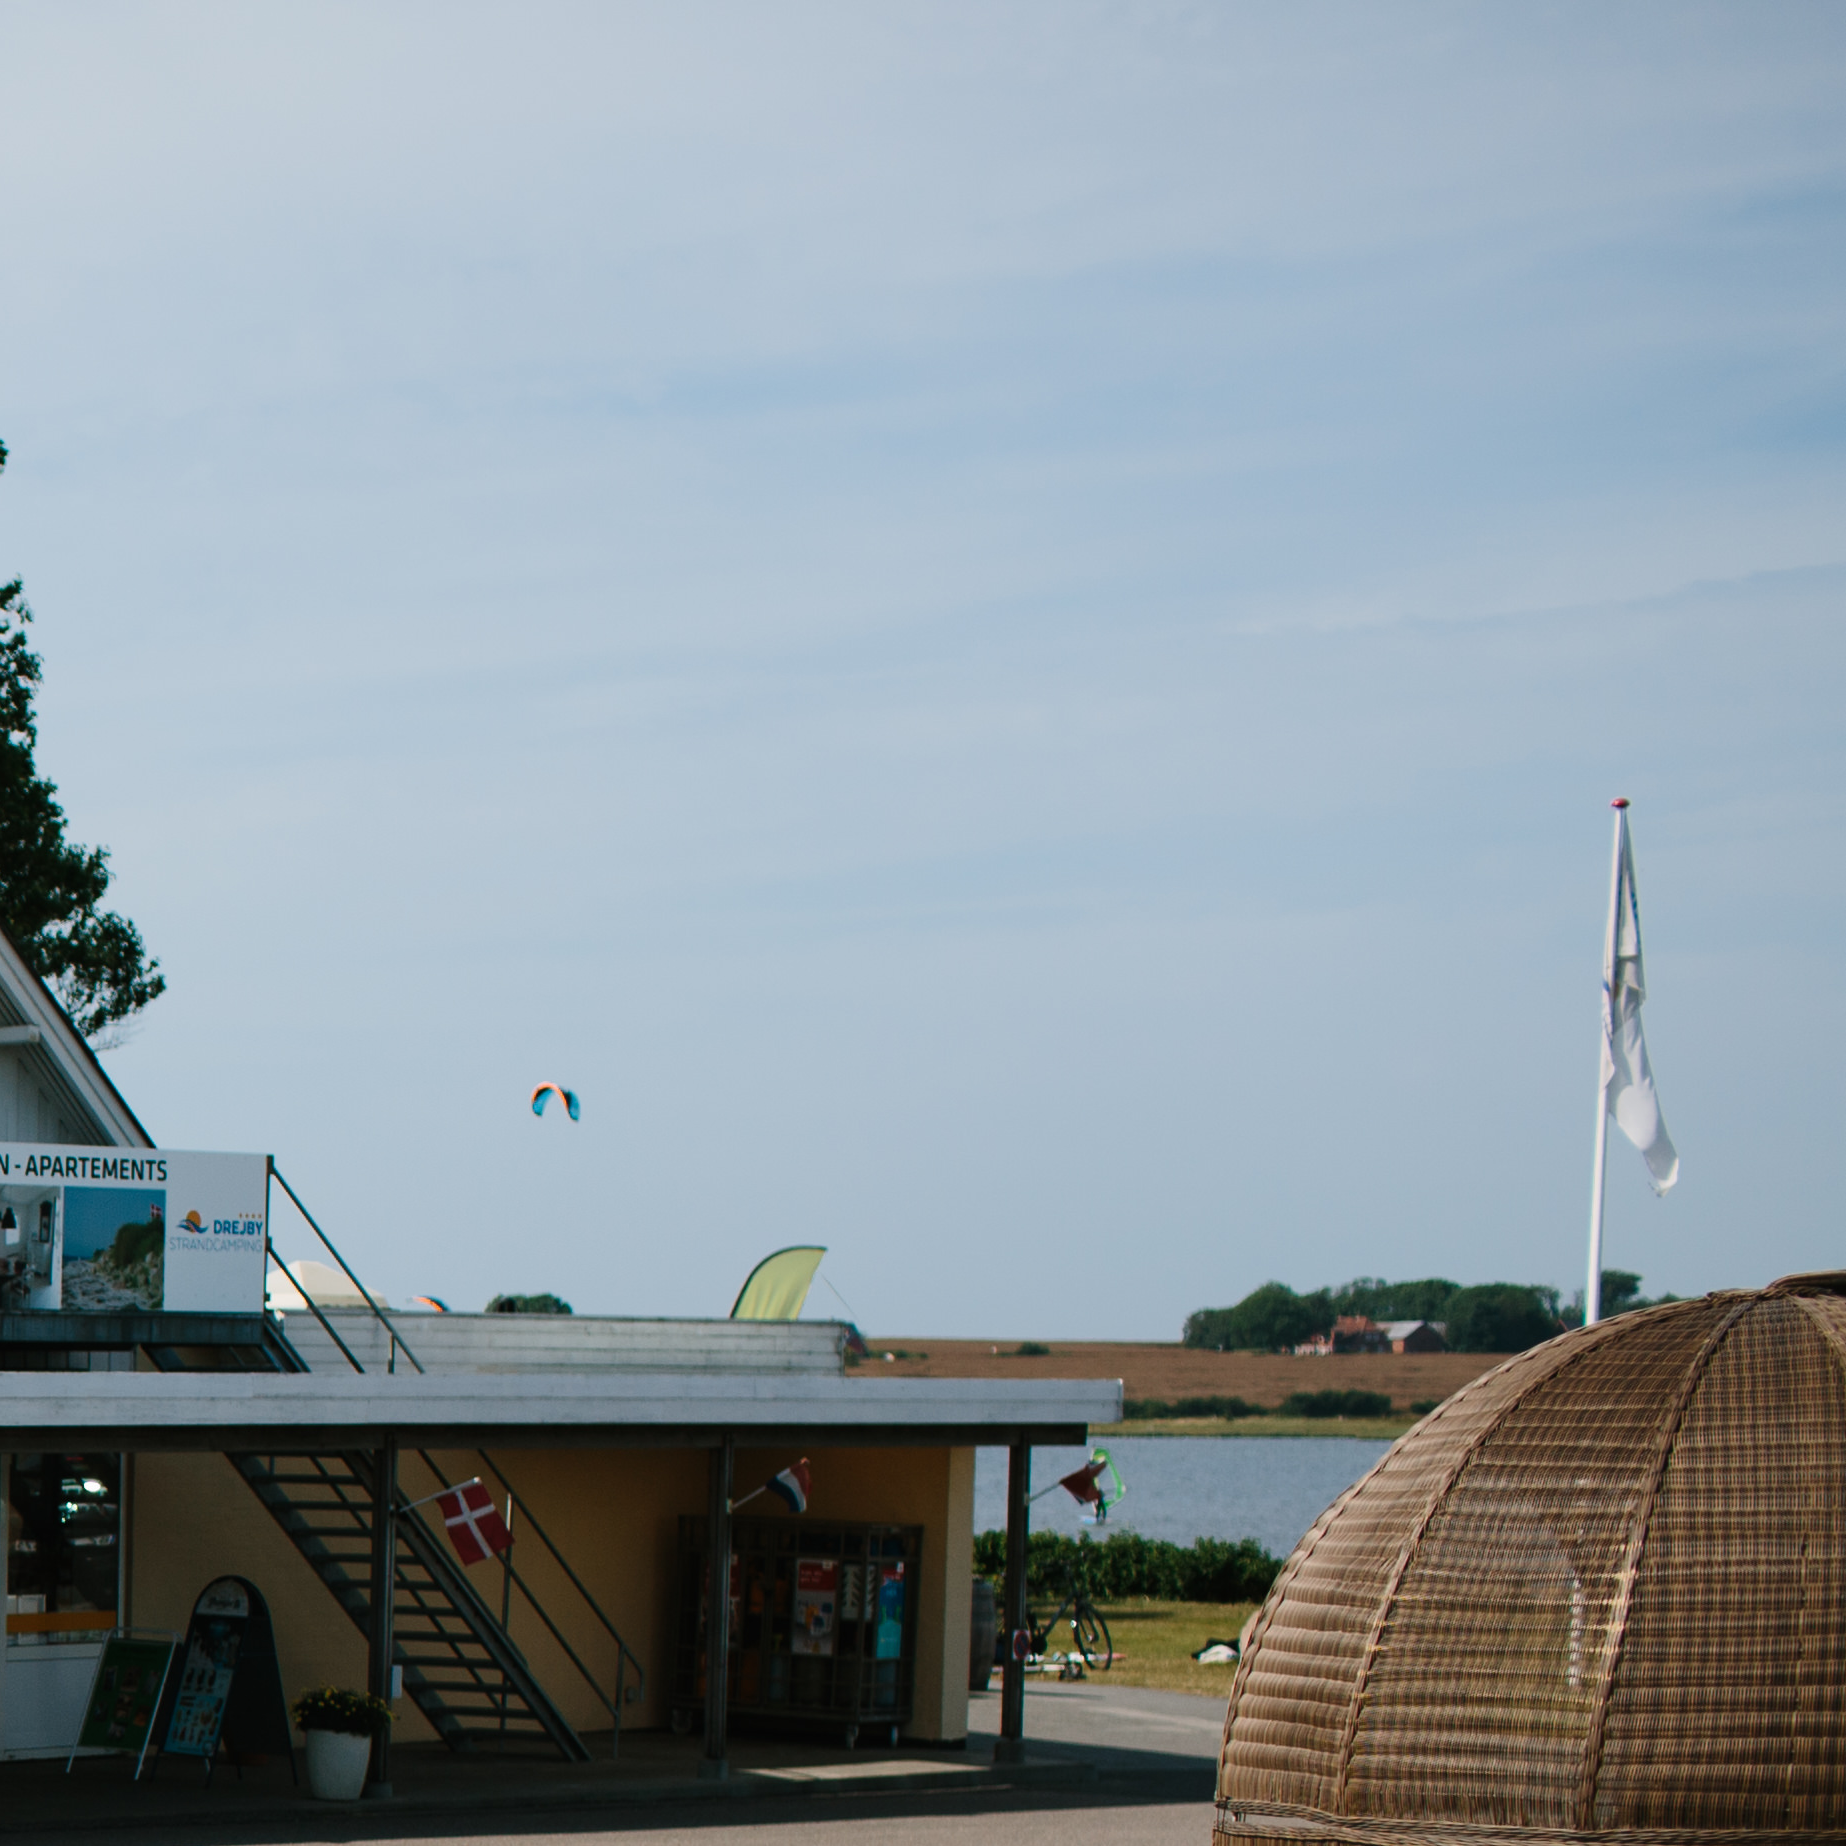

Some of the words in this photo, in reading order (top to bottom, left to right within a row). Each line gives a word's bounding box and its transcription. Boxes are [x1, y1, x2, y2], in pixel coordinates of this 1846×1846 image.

[25, 1154, 167, 1181] APARTEMENTS
[213, 1219, 263, 1236] DREJBY
[170, 1236, 263, 1253] STRANDCAMPING
